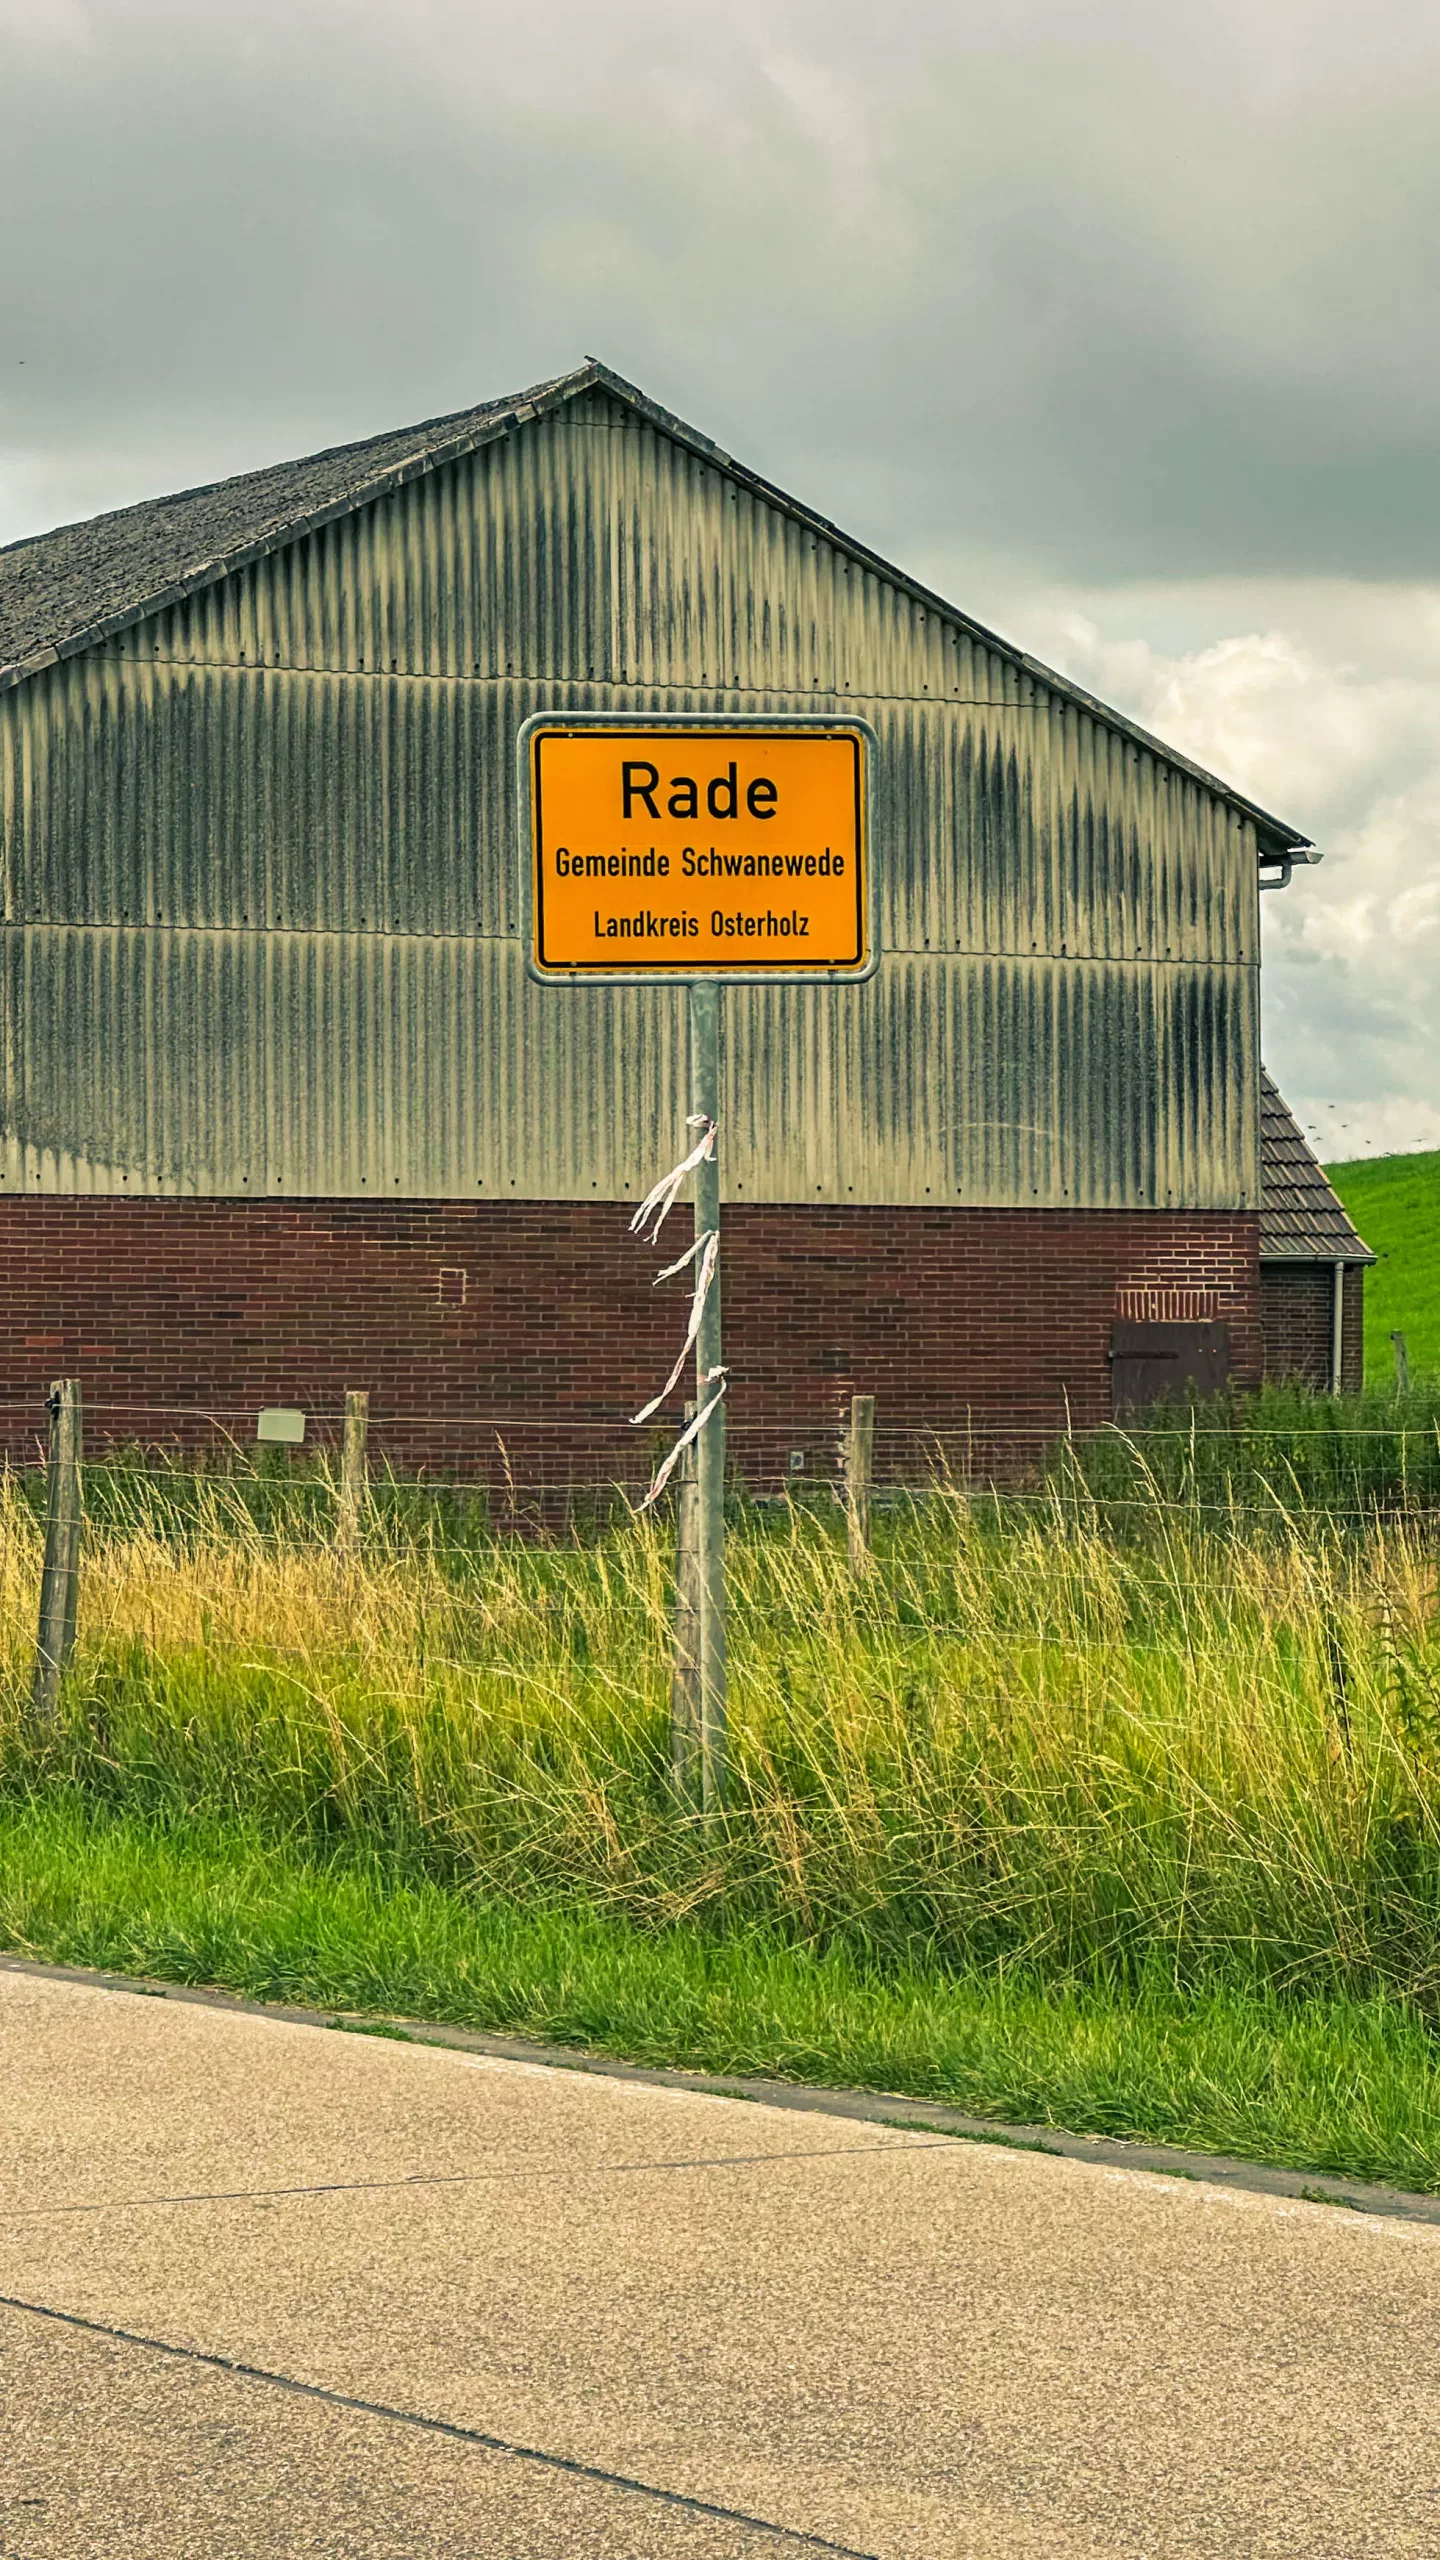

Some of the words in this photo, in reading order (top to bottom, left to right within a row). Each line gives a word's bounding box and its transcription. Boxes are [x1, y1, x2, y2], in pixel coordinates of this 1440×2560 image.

[621, 761, 778, 820] Rade
[555, 847, 670, 877] Gemeinde
[682, 847, 845, 877] Schwanewede
[594, 911, 699, 938] Landkreis
[711, 910, 809, 937] Osterholz
